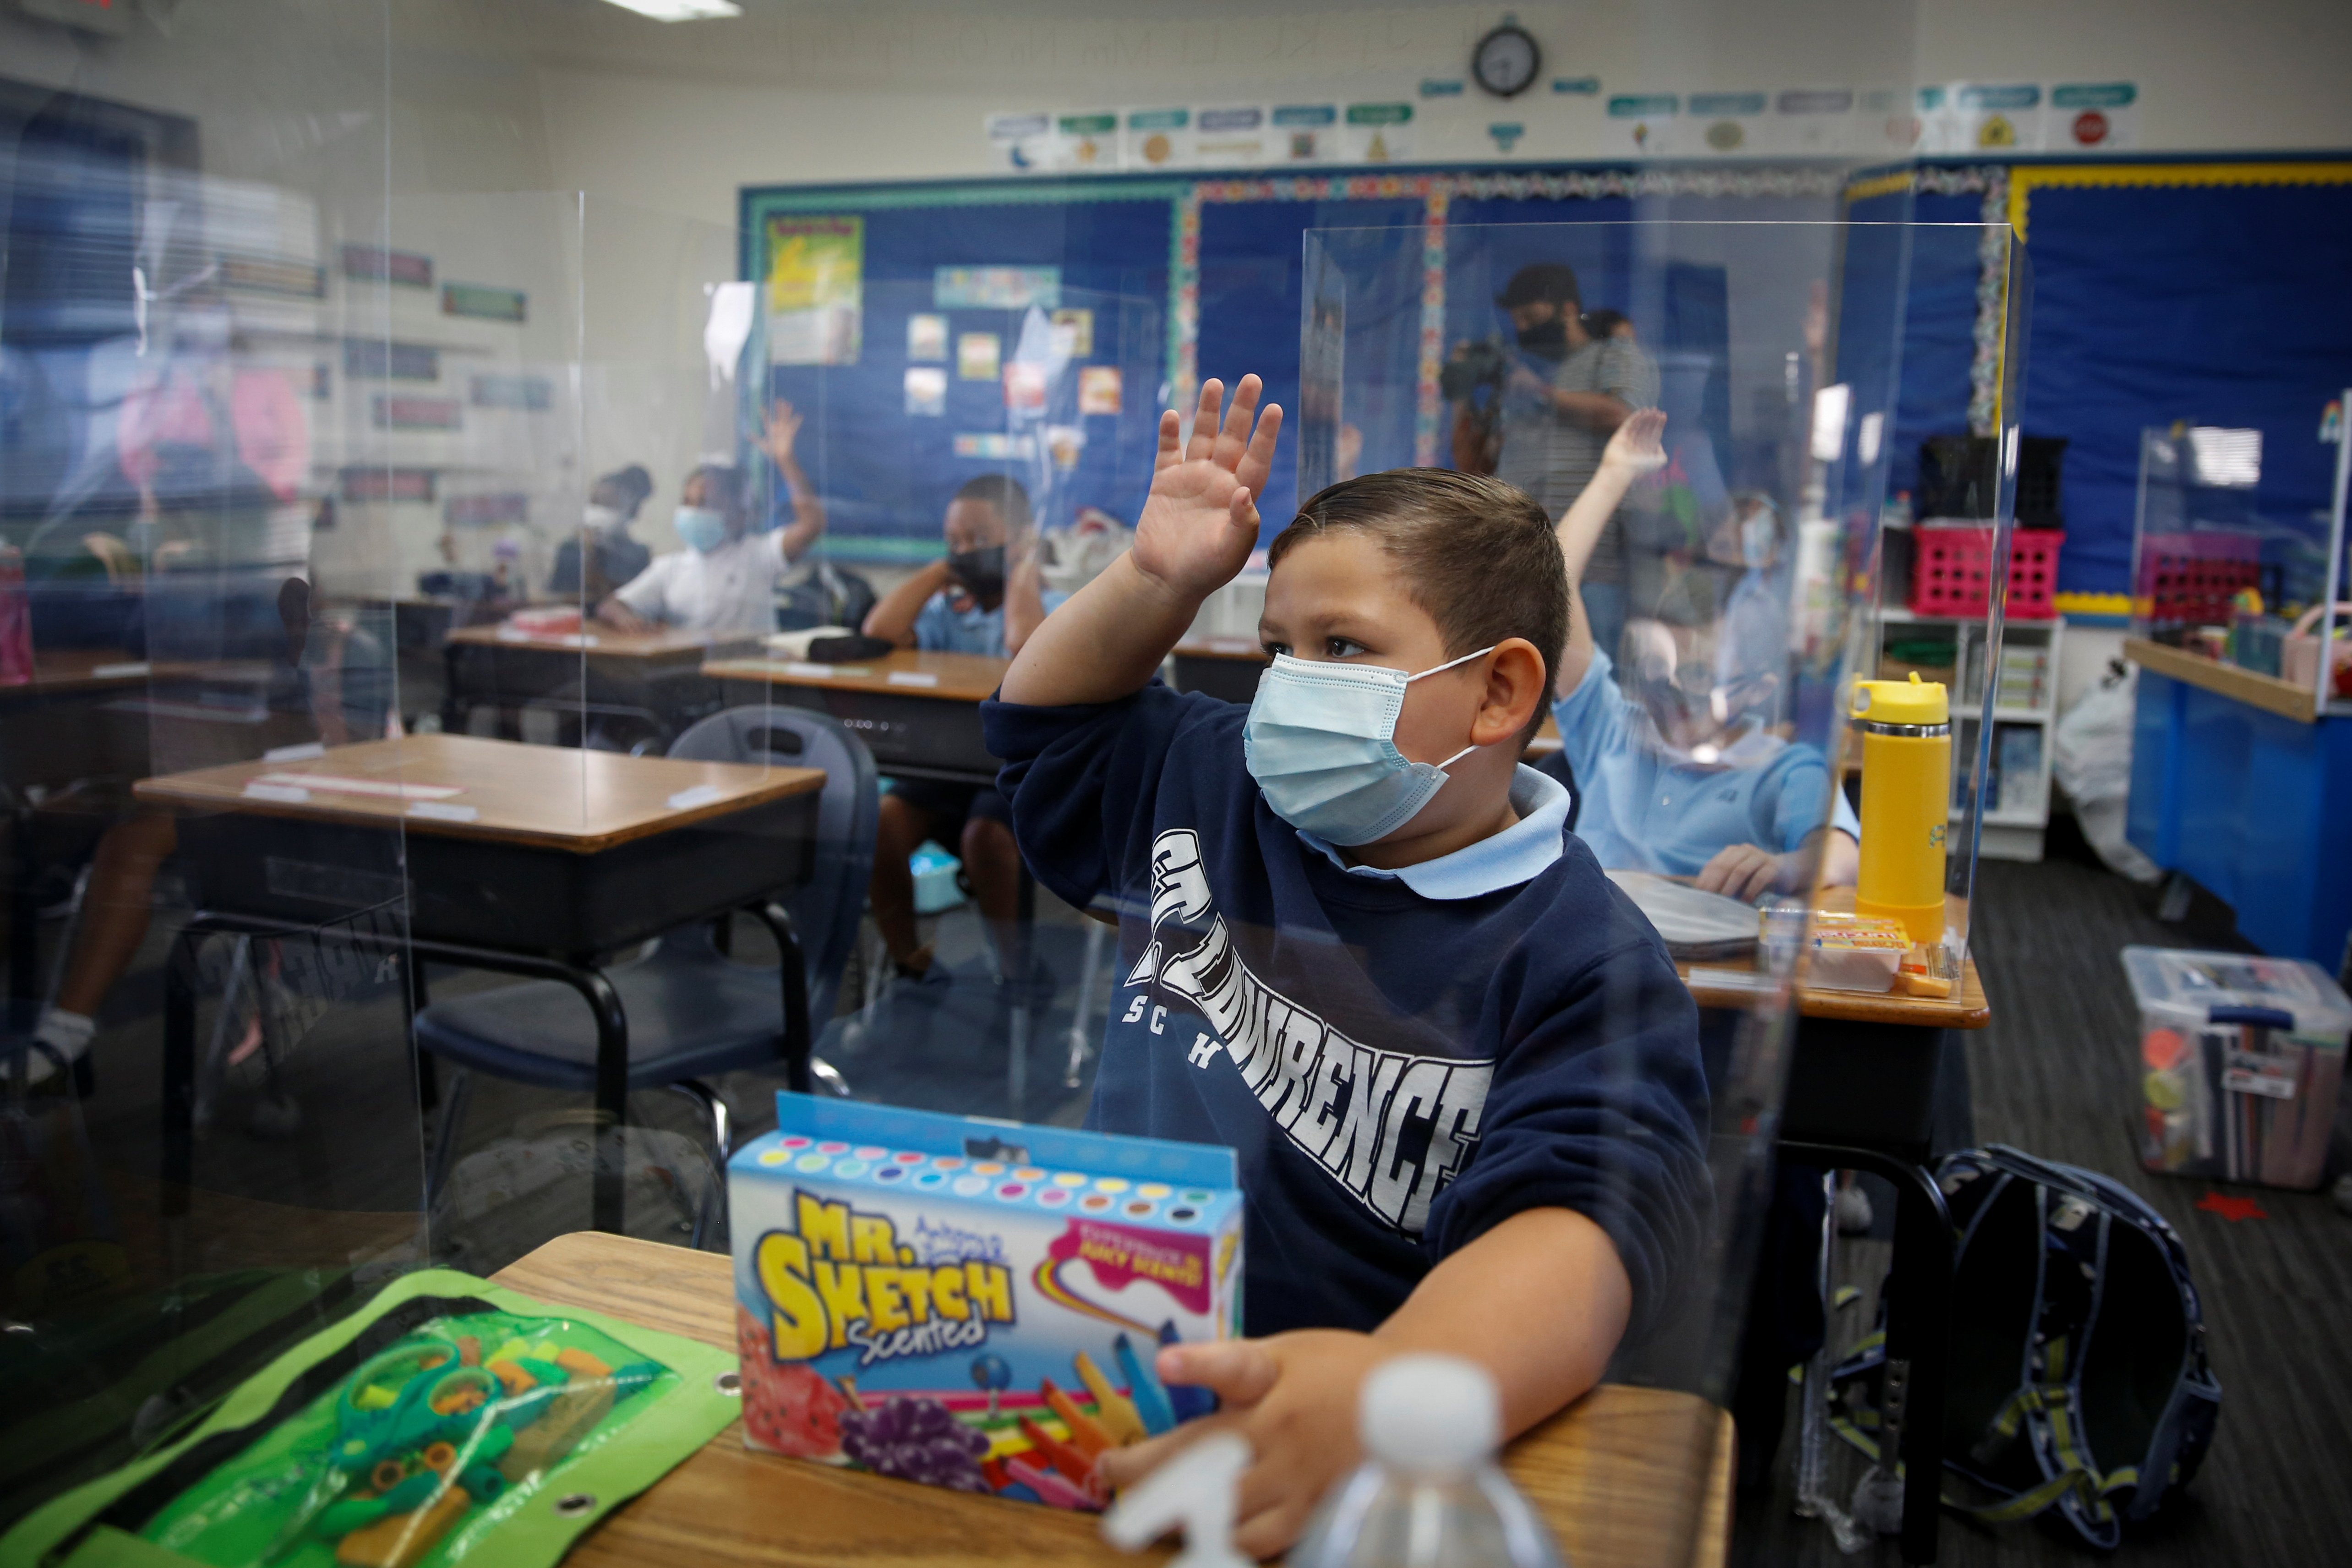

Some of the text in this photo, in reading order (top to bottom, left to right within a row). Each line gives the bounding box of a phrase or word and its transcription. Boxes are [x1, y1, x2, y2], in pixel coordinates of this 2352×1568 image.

[1159, 912, 1495, 1245] LAWRENCE
[794, 1187, 917, 1268] MR.
[755, 1230, 1015, 1362] SKETCH
[847, 1298, 985, 1366] Scented
